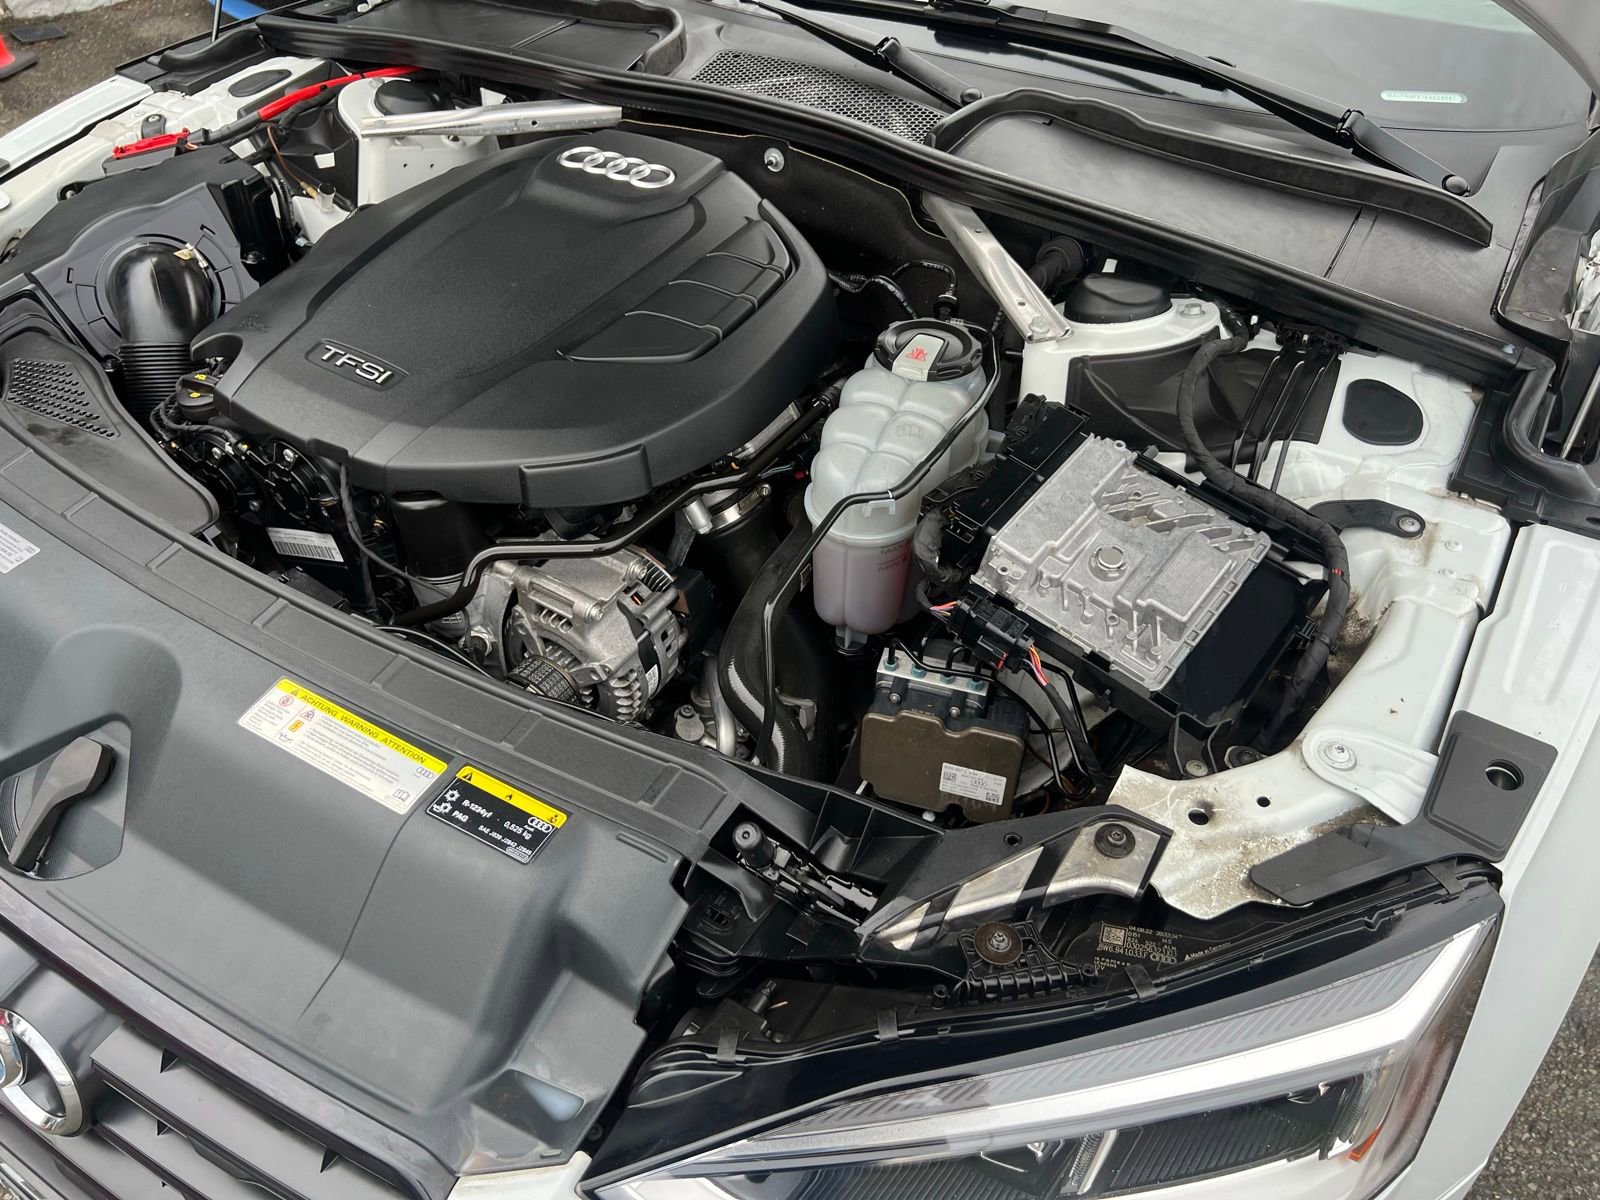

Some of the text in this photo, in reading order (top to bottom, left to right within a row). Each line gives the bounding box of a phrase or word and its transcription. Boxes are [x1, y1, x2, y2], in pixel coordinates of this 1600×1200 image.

[321, 345, 393, 384] TFSI
[300, 694, 339, 717] ACHTUNG
[340, 714, 380, 738] WARNING
[381, 737, 427, 764] ATTENTION
[451, 810, 469, 823] PAG
[461, 799, 493, 818] R-1234yf
[521, 828, 533, 840] kg
